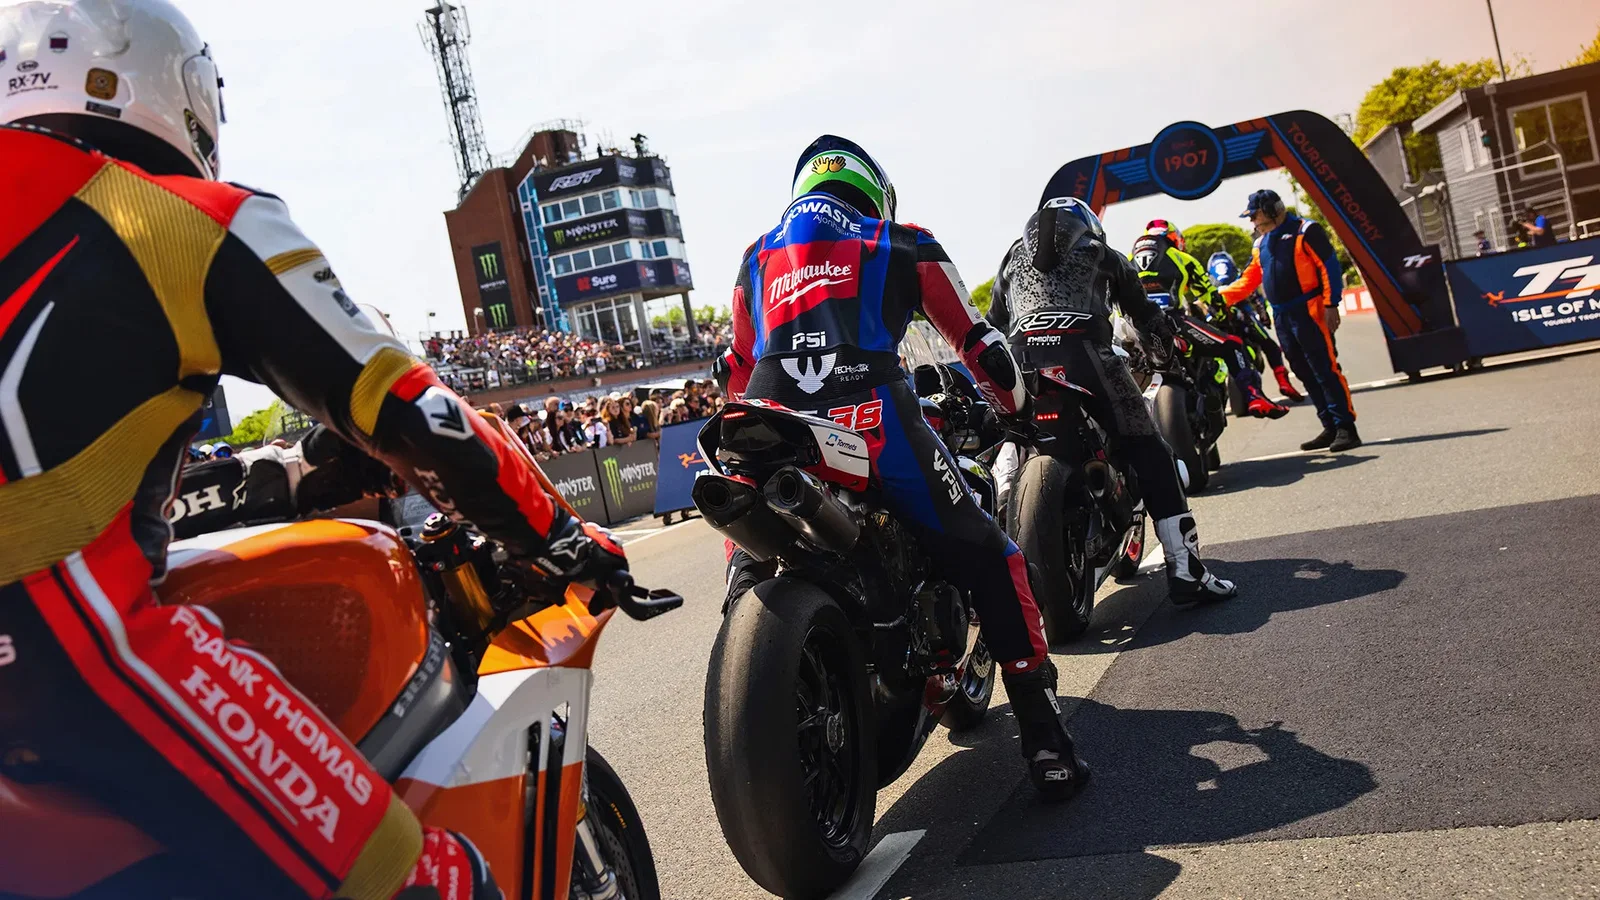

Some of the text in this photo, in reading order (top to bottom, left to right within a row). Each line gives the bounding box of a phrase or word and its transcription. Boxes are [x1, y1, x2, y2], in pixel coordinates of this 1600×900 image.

[9, 72, 51, 90] RX-7V
[1164, 150, 1208, 173] 1907
[549, 168, 602, 191] RST
[1288, 121, 1383, 240] TOURIST TROPHY
[591, 274, 617, 287] Sure
[767, 260, 852, 304] Milwaukee
[1511, 305, 1555, 322] ISLE
[1557, 300, 1585, 314] OF
[1009, 312, 1093, 337] RST
[840, 374, 865, 382] READY
[620, 462, 657, 483] MONSTER
[629, 481, 654, 493] ENERGY
[170, 606, 373, 806] FRANK THOMAS
[180, 665, 341, 843] HONDA
